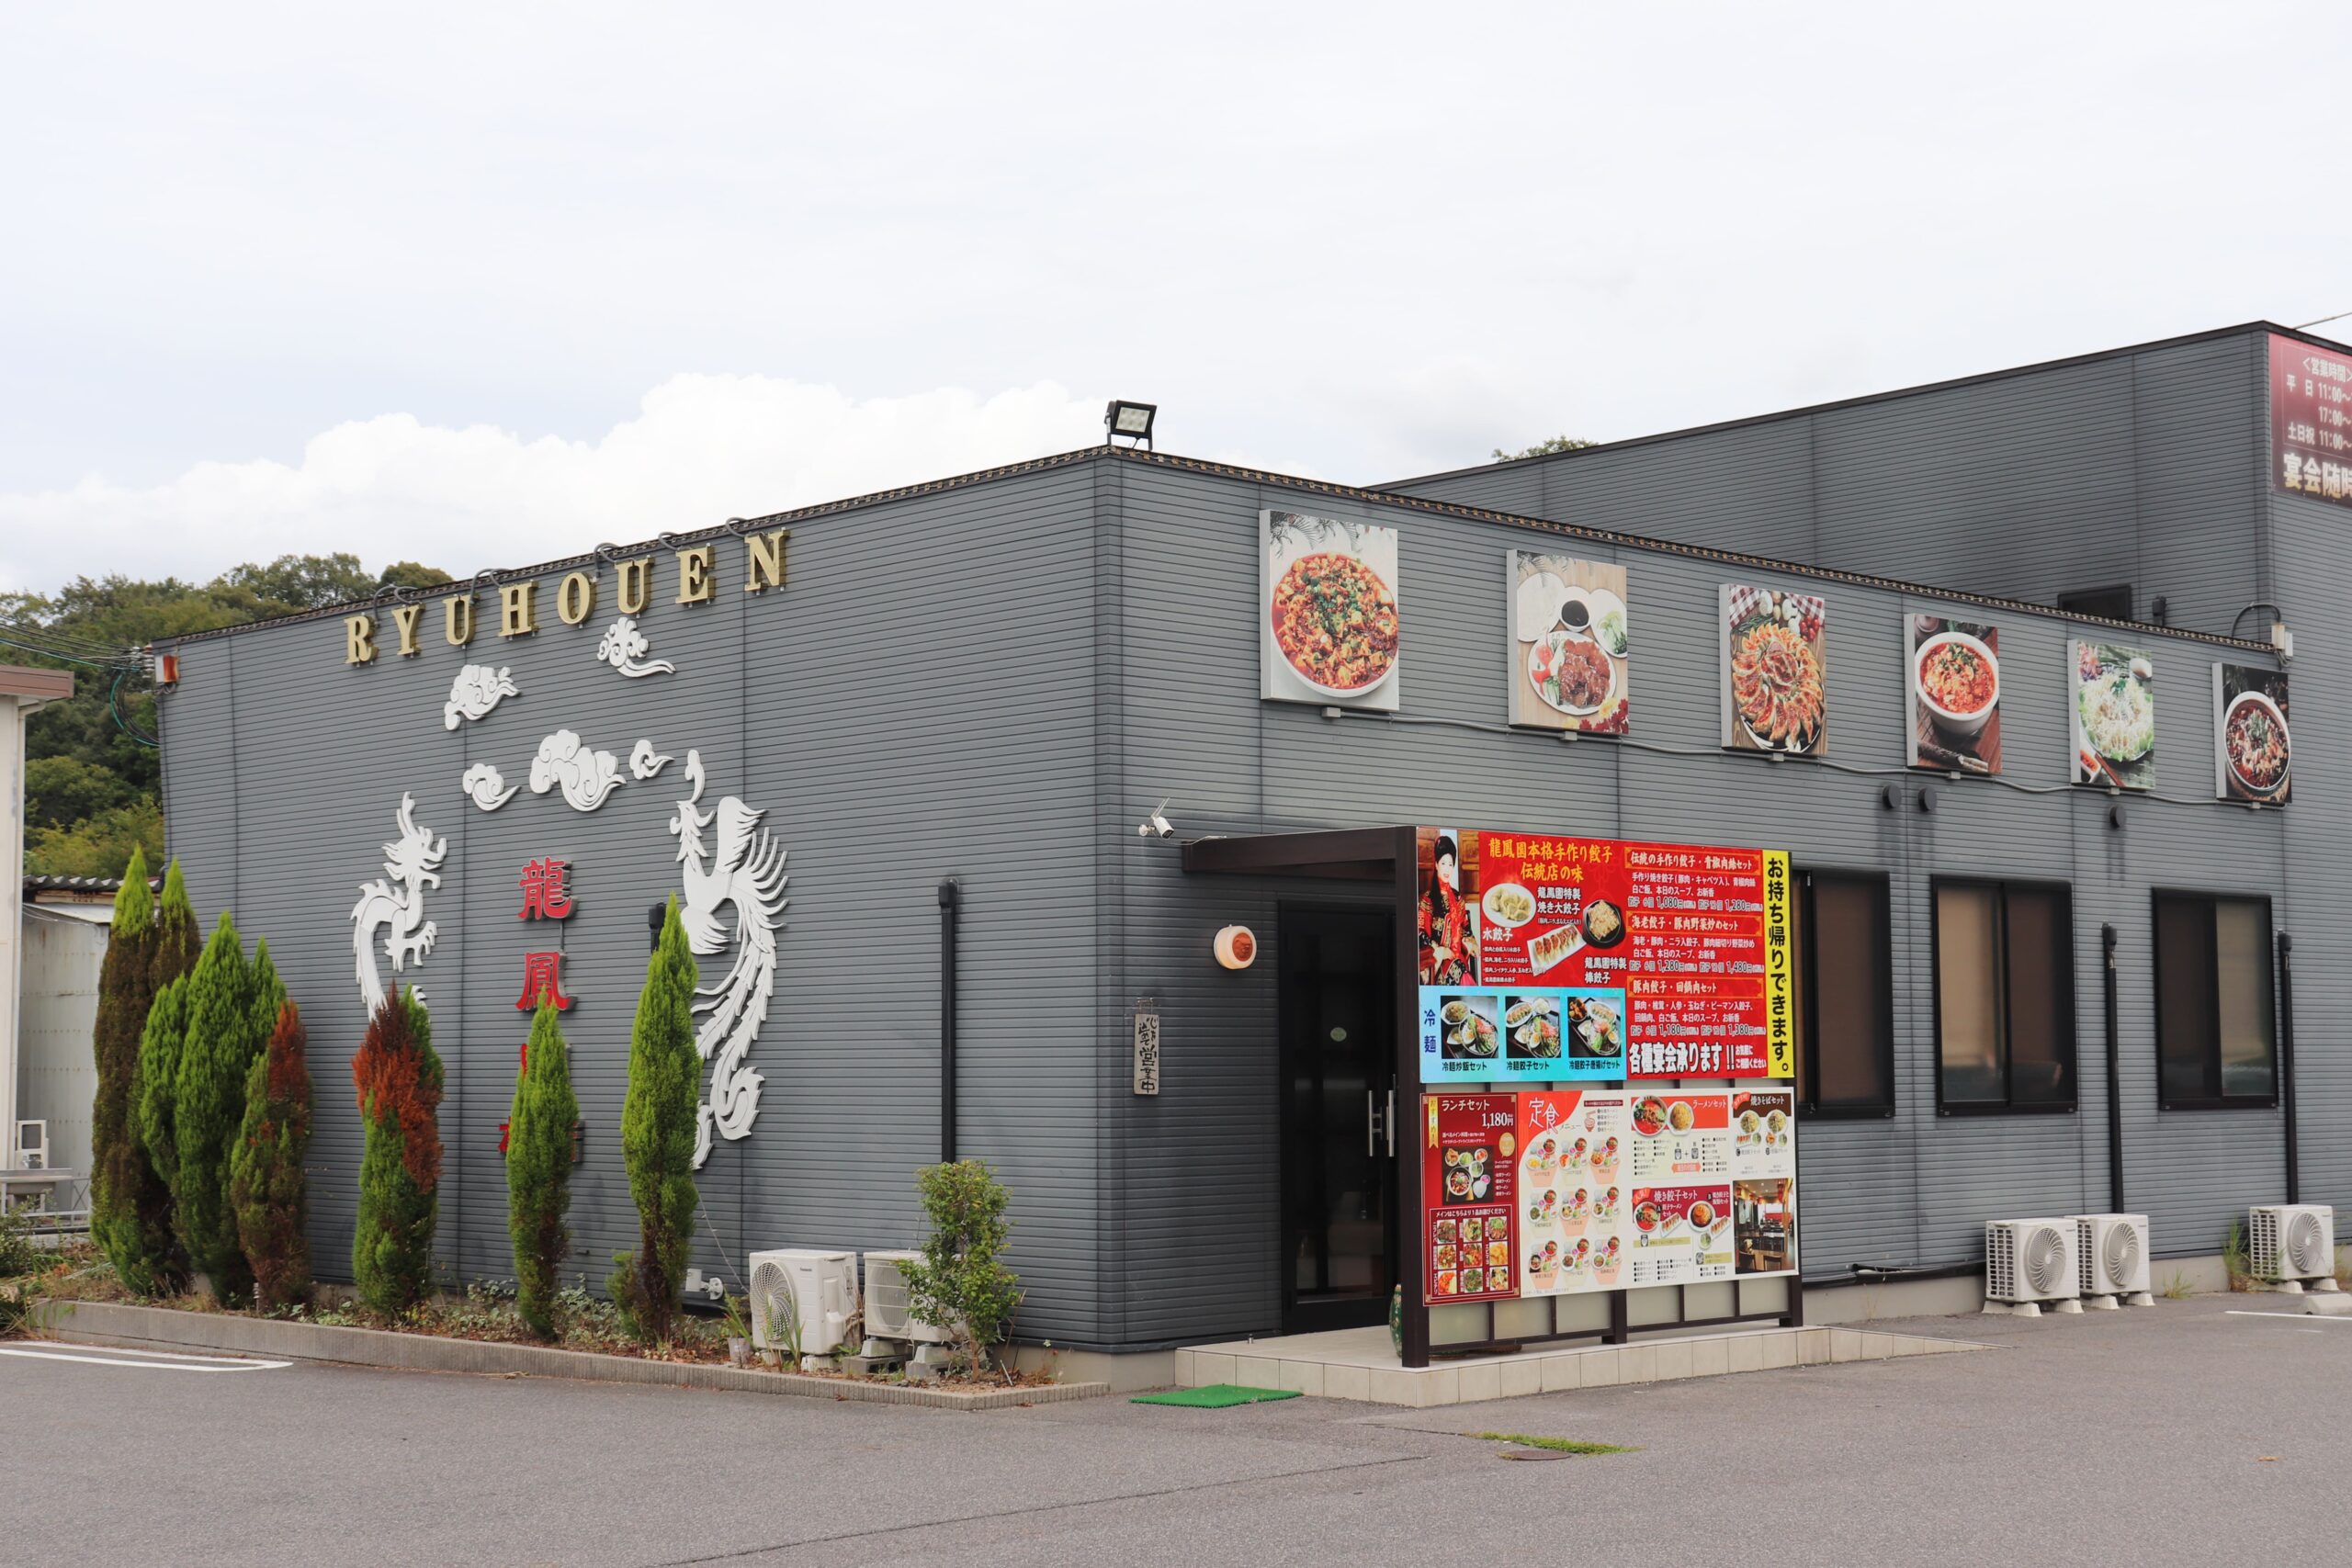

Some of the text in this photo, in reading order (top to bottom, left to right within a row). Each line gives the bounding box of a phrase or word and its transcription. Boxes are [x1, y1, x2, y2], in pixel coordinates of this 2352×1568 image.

[2288, 421, 2315, 446] 土日祝
[345, 526, 790, 665] RYUHOUEN
[1521, 862, 1585, 884] 伝統店の味
[1483, 927, 1513, 942] 水餃子
[1768, 857, 1790, 1072] お持ち帰りできます。
[1442, 1099, 1490, 1111] ランチセット
[1529, 1097, 1559, 1134] 定食
[1692, 1099, 1727, 1109] ラーメンセット
